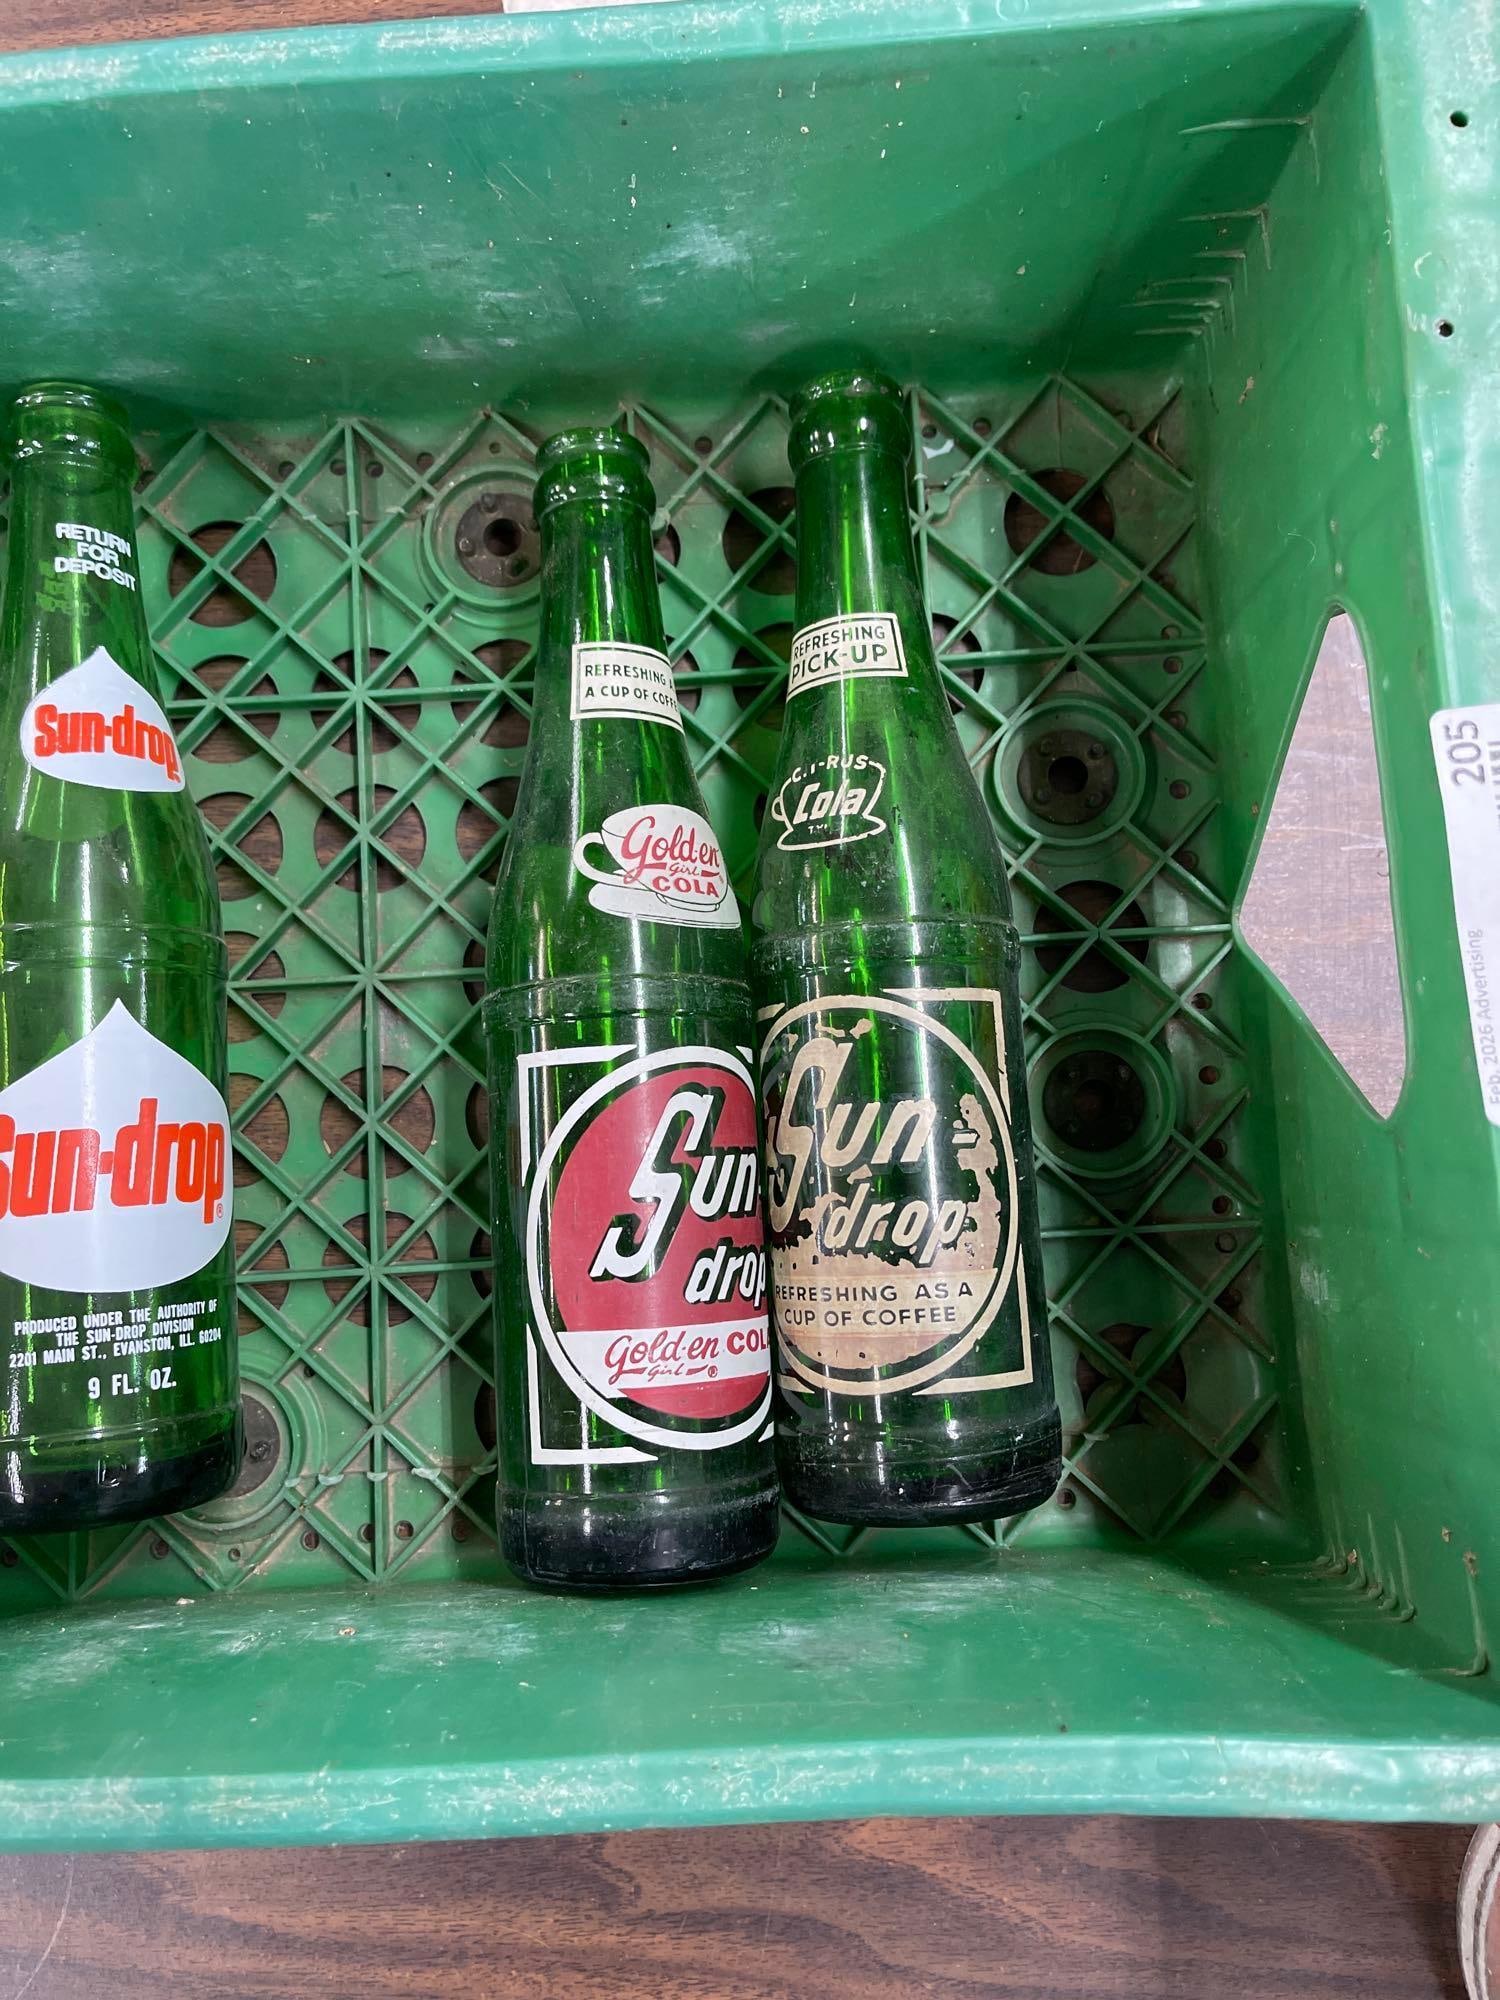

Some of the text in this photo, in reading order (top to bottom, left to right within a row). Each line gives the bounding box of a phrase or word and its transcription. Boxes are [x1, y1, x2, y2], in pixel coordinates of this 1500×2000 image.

[56, 523, 131, 557] RETURN
[77, 542, 120, 567] FOR
[54, 557, 136, 592] DEPOSIT
[794, 626, 885, 660] REFRESHING
[585, 664, 666, 686] REFRESHING
[792, 644, 888, 684] PICK-UP
[585, 686, 595, 698] A
[600, 685, 629, 697] CUP
[633, 687, 649, 700] OF
[34, 704, 179, 781] Sun-drop
[1444, 720, 1485, 786] 205
[793, 779, 867, 825] Cola
[652, 875, 719, 898] COLA
[1468, 929, 1492, 1021] Advertising
[1478, 1023, 1499, 1065] 2026
[823, 1183, 967, 1264] drop
[685, 1246, 766, 1307] drop
[776, 1281, 973, 1302] REFRESHING AS A
[14, 1299, 218, 1335] PRODUCED UNDER THE AUTHORITY OF
[56, 1318, 194, 1347] THE SUN-DROP DIVISION
[784, 1306, 956, 1327] CUP OF COFFEE
[9, 1352, 37, 1368] 2201
[43, 1348, 75, 1365] MAIN
[113, 1337, 175, 1357] EVANSTON,
[179, 1332, 195, 1347] ILL.
[199, 1327, 221, 1345] 60204
[726, 1326, 769, 1355] COL
[88, 1367, 177, 1399] 9 FL. OZ.
